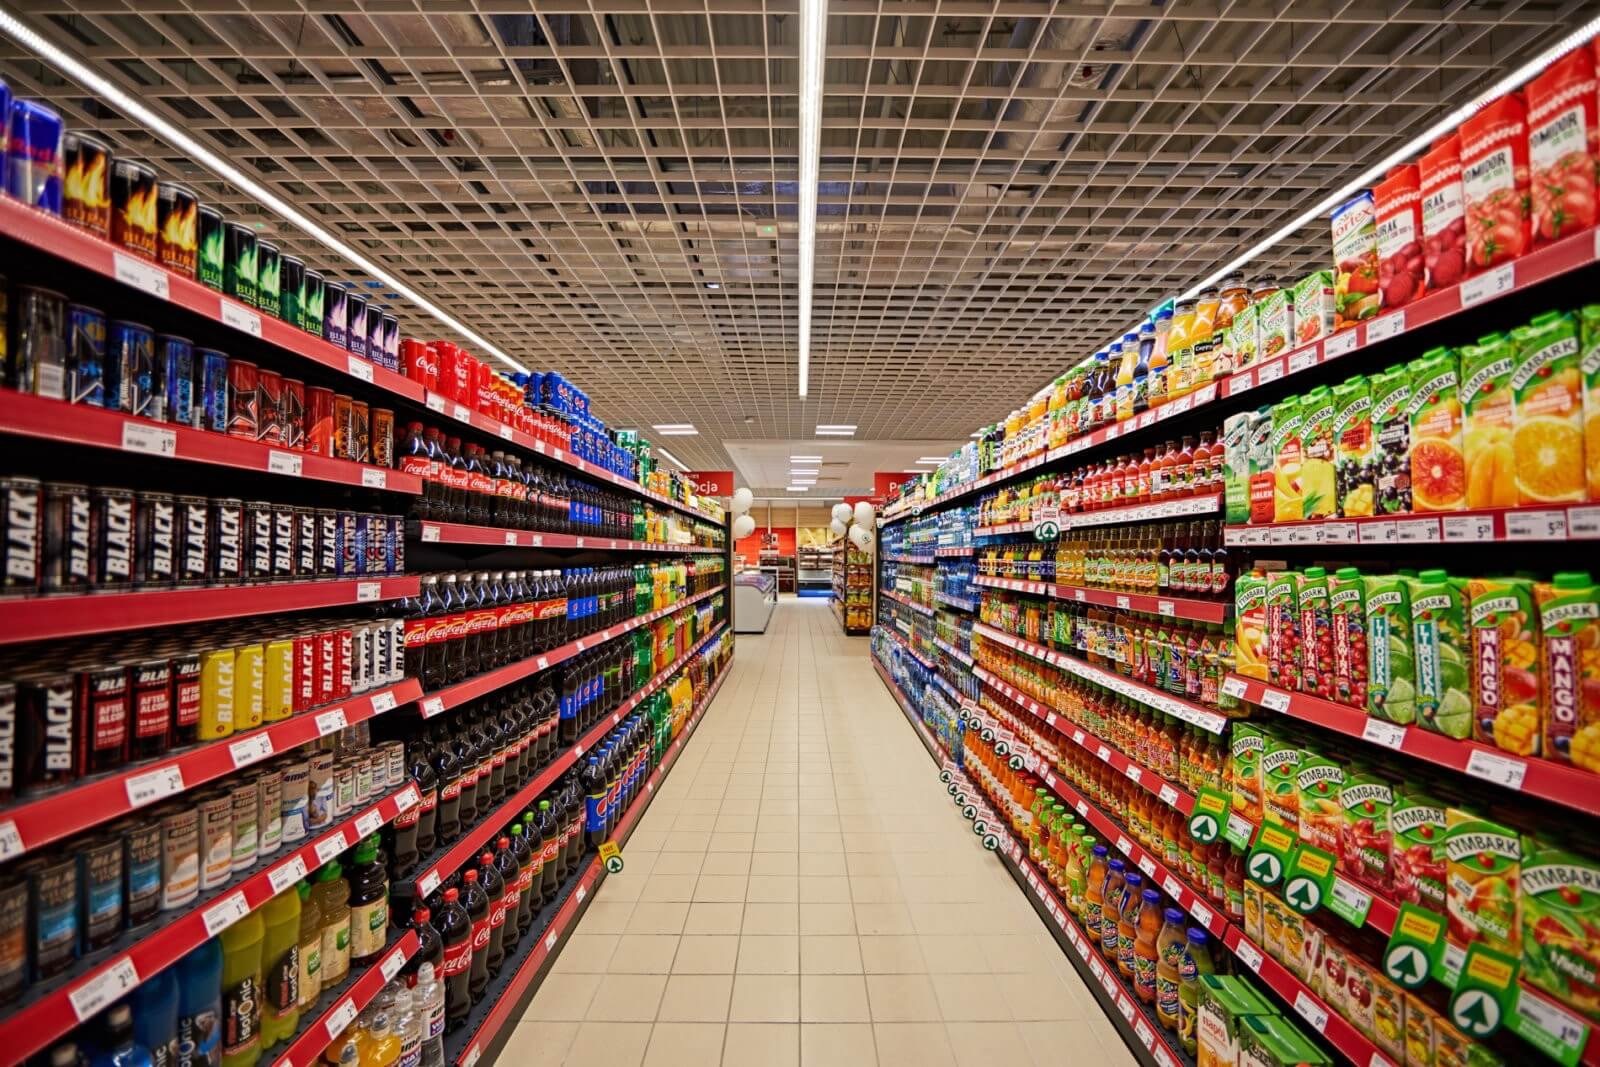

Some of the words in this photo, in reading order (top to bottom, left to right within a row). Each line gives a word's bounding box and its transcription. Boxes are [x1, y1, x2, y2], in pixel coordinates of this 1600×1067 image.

[1409, 372, 1455, 411] TYMBARK
[1463, 359, 1513, 402] TYMBARK
[1514, 340, 1575, 386] TYMBARK
[1301, 407, 1333, 440] TYMBARK
[1335, 398, 1370, 432] TYMBARK
[7, 489, 38, 579] BLACK
[71, 496, 91, 577] BLACK
[106, 498, 131, 576] BLACK
[153, 502, 174, 575] BLACK
[187, 504, 207, 574] BLACK
[220, 507, 239, 573] BLACK
[255, 510, 270, 572] BLACK
[276, 512, 291, 571] BLACK
[301, 514, 314, 570] BLACK
[323, 515, 336, 569] BLACK
[1239, 587, 1265, 609] TYMBARK
[303, 643, 313, 698] BLACK
[323, 639, 333, 692] BLACK
[342, 635, 351, 686] BLACK
[1376, 620, 1385, 684] LIMONKA
[1419, 624, 1435, 697] LIMONKA
[1481, 629, 1498, 705] MANGO
[1551, 639, 1575, 721] MANGO
[217, 661, 234, 722] BLACK
[252, 654, 264, 713] BLACK
[46, 689, 73, 770] BLACK
[1232, 736, 1263, 754] TYMBARK
[1299, 766, 1343, 786] TYMBARK
[1343, 785, 1391, 806] TYMBARK
[1447, 833, 1519, 857] TYMBARK
